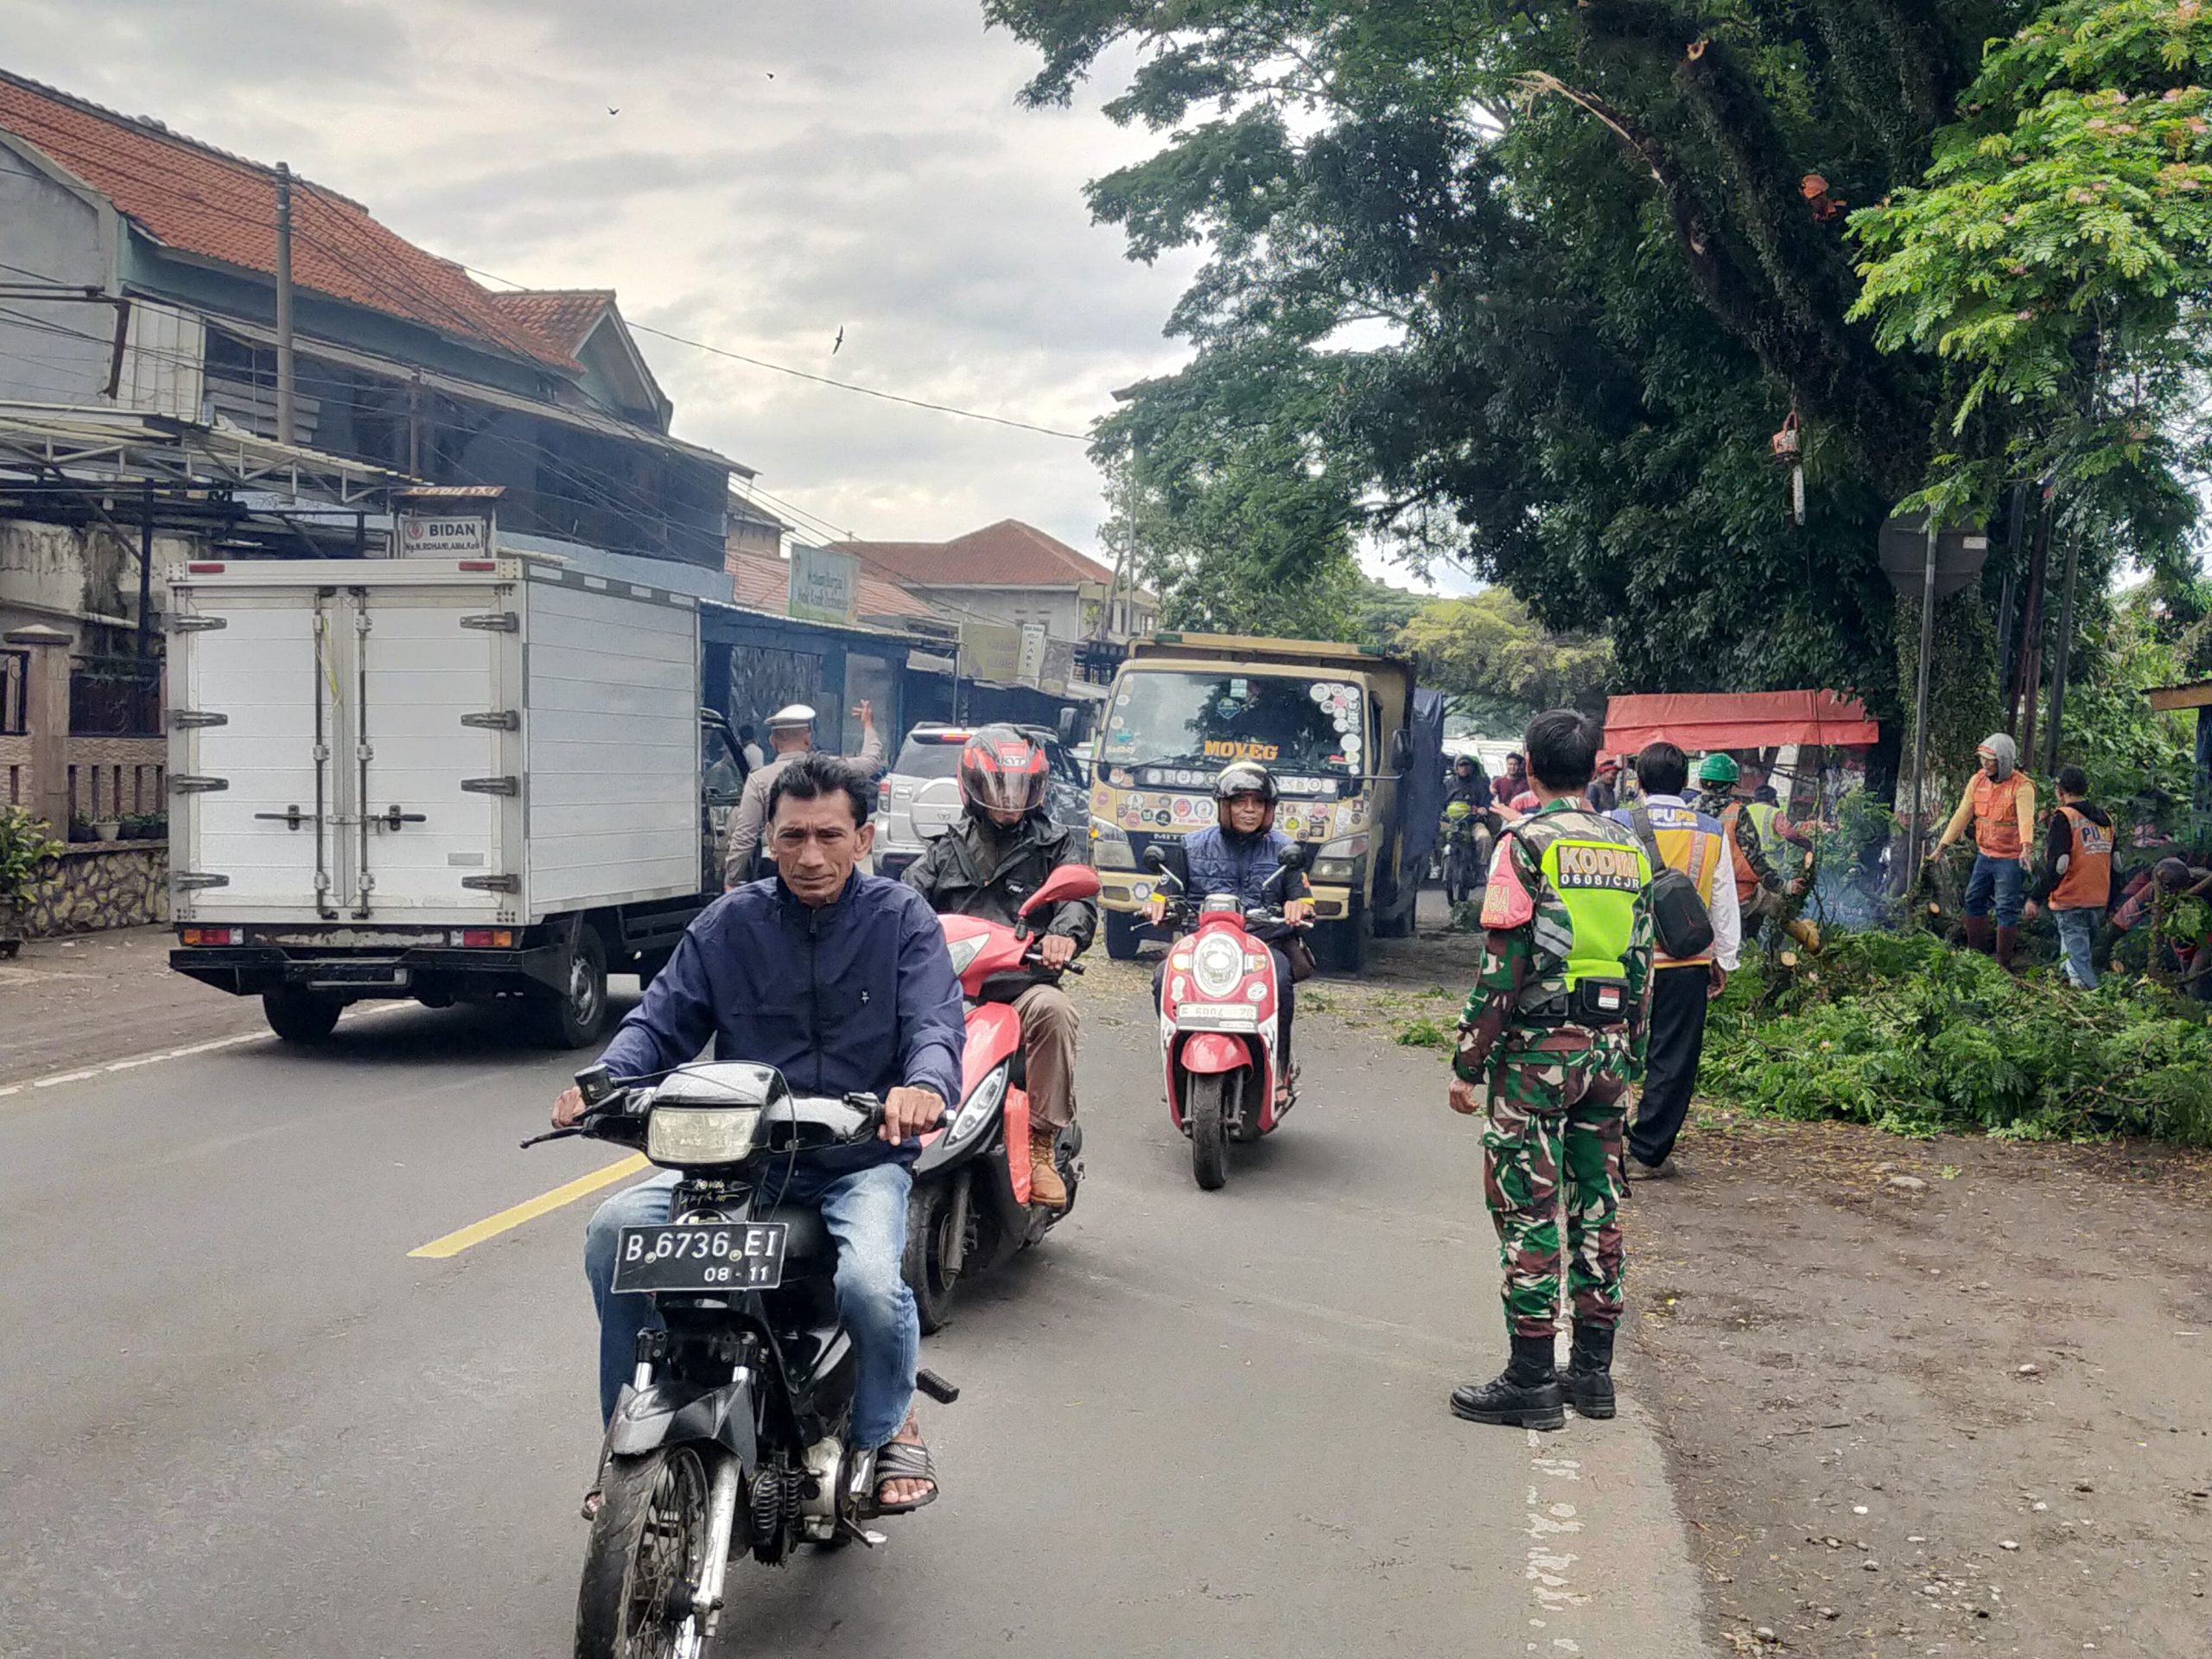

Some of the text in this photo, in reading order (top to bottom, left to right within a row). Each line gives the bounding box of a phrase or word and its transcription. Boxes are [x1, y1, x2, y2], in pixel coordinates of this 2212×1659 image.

[429, 524, 475, 537] BIDAN
[1203, 740, 1279, 760] MOVEG
[1560, 874, 1640, 889] 0608/CJR
[626, 1230, 776, 1262] B 6736 EI
